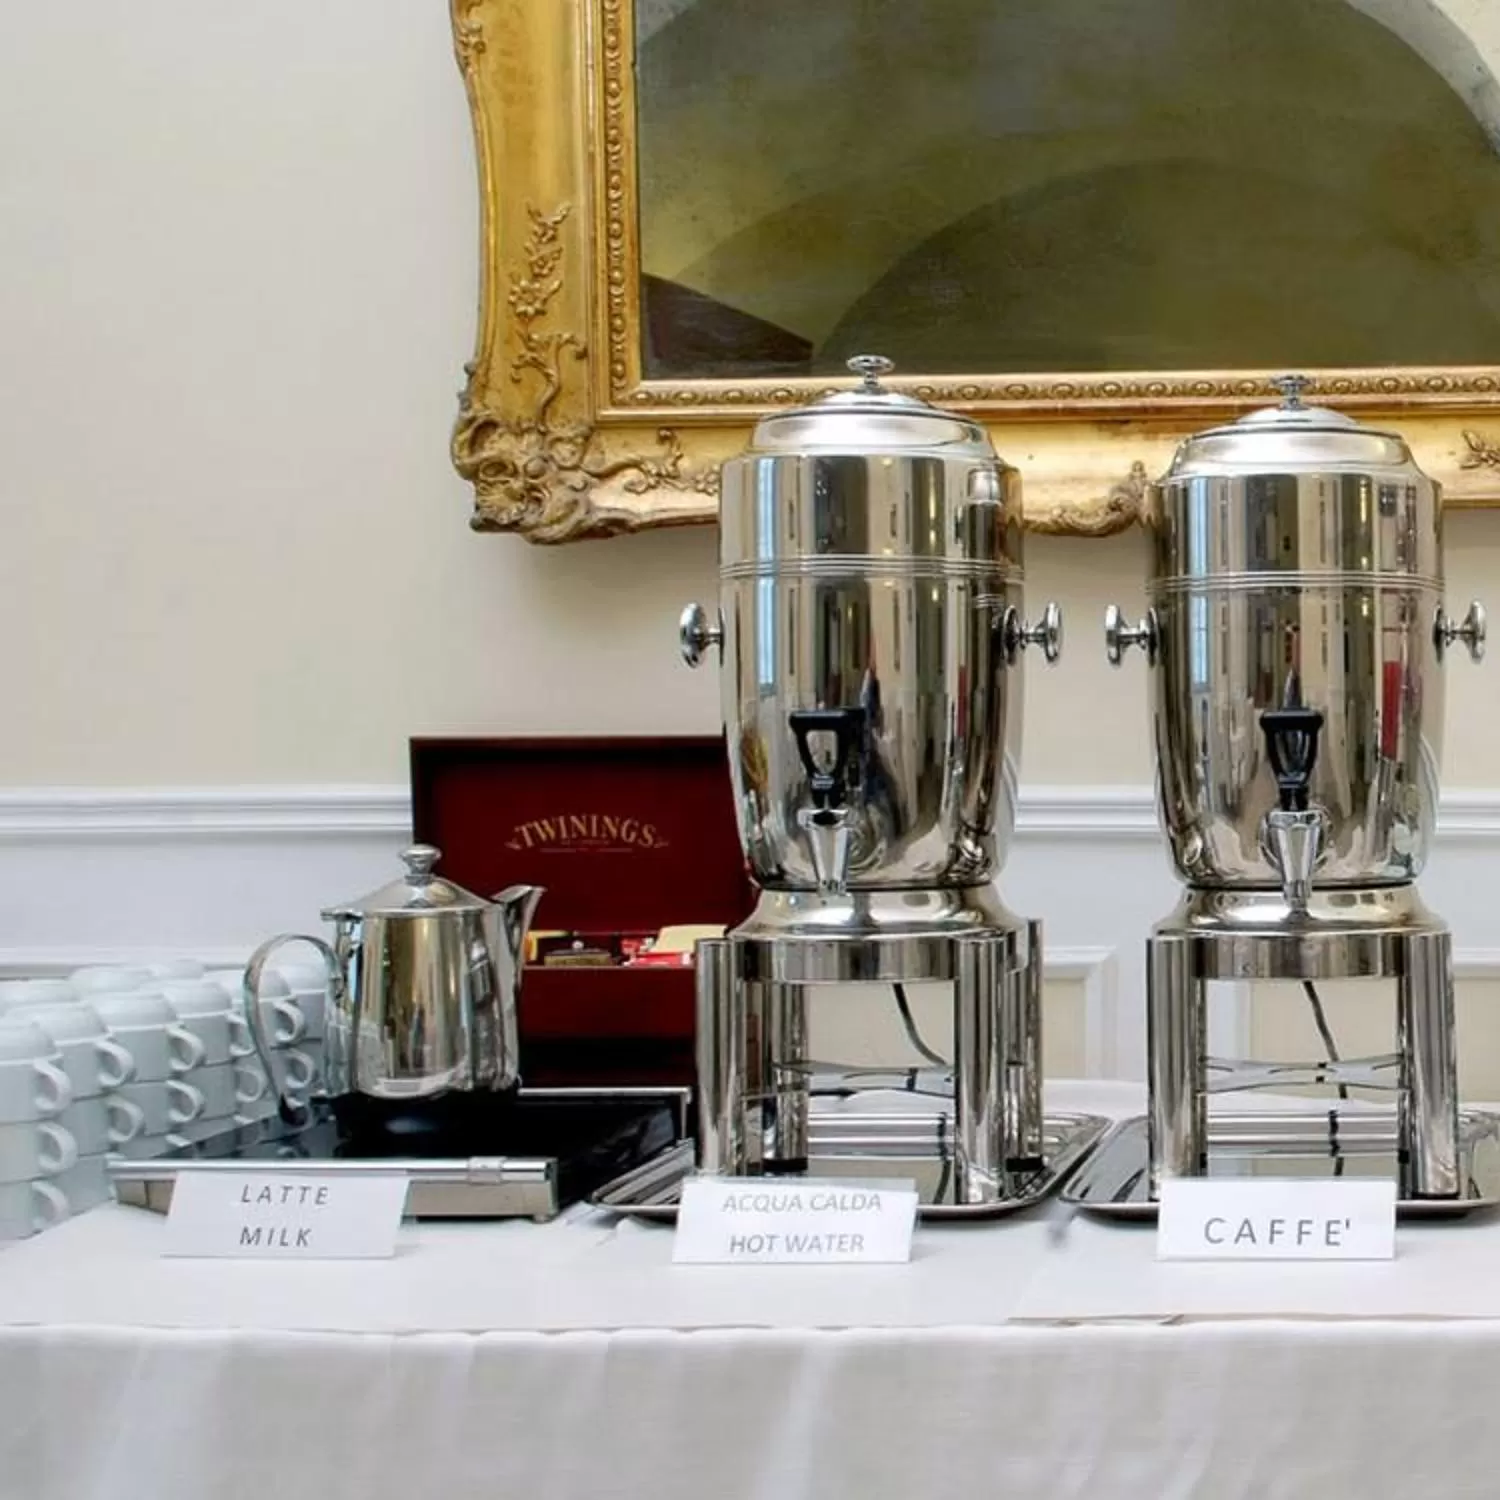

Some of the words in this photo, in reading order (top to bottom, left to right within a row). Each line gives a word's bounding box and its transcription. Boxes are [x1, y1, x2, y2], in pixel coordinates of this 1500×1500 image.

[514, 814, 656, 849] TWININGS
[241, 1184, 328, 1205] LATTE
[722, 1193, 803, 1213] ACQUA
[809, 1193, 881, 1213] CALDA
[240, 1227, 312, 1247] MILK
[1203, 1217, 1351, 1247] CAFFE'
[729, 1234, 779, 1253] HOT
[784, 1234, 864, 1253] WATER
